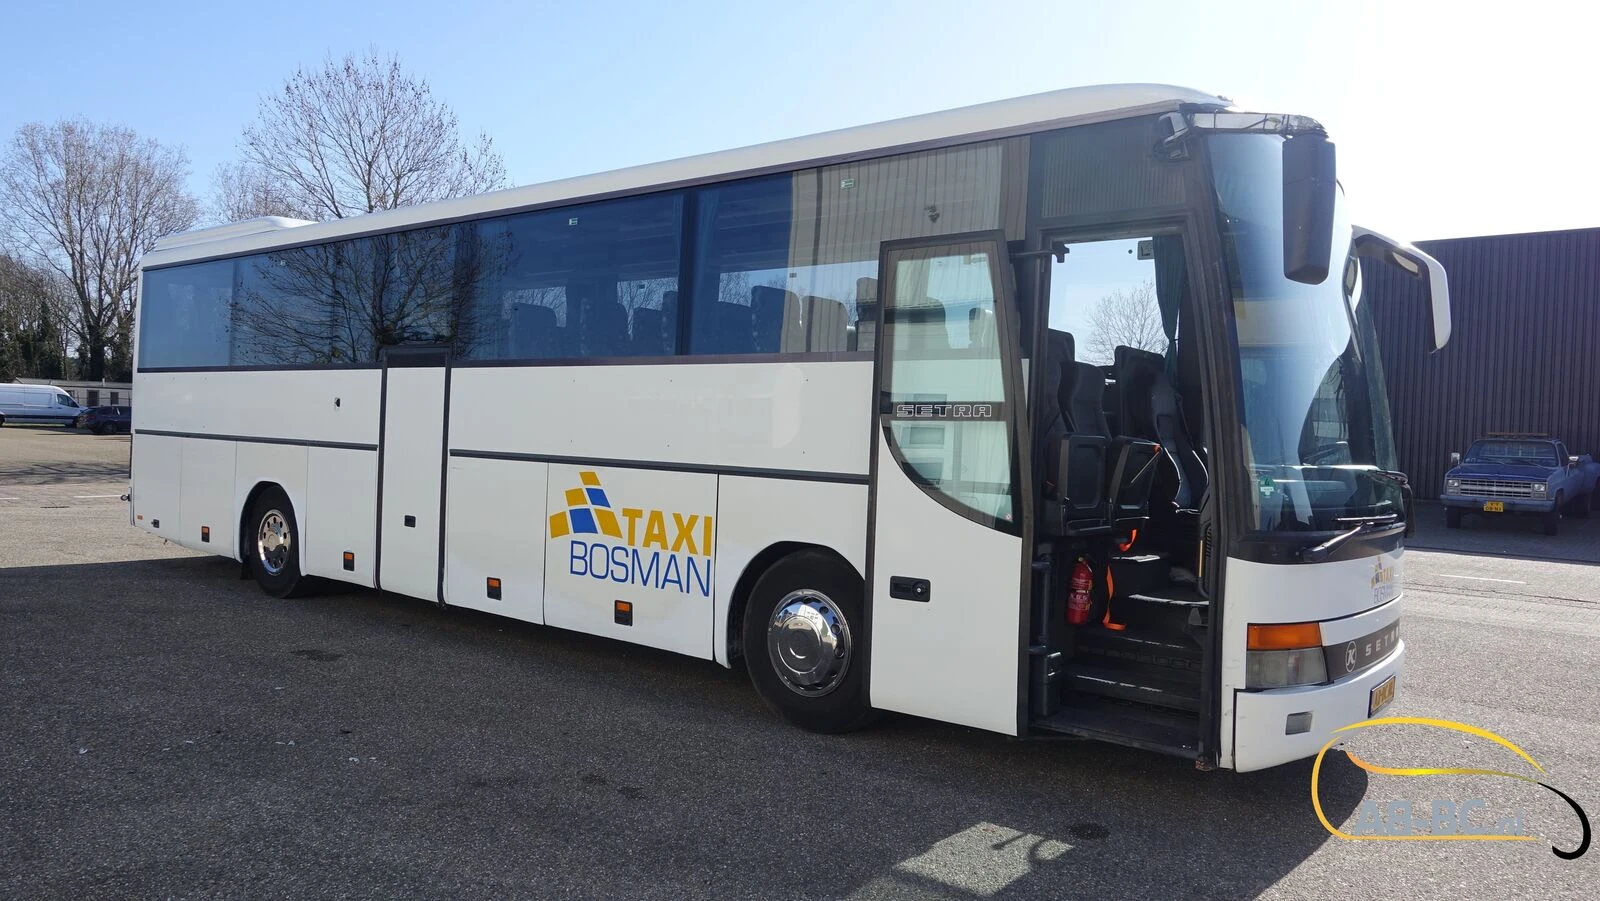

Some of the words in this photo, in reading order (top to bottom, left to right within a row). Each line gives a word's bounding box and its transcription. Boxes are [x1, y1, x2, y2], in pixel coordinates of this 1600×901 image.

[896, 404, 992, 418] SETRA
[622, 507, 713, 557] TAXI
[569, 540, 711, 598] BOSMAN
